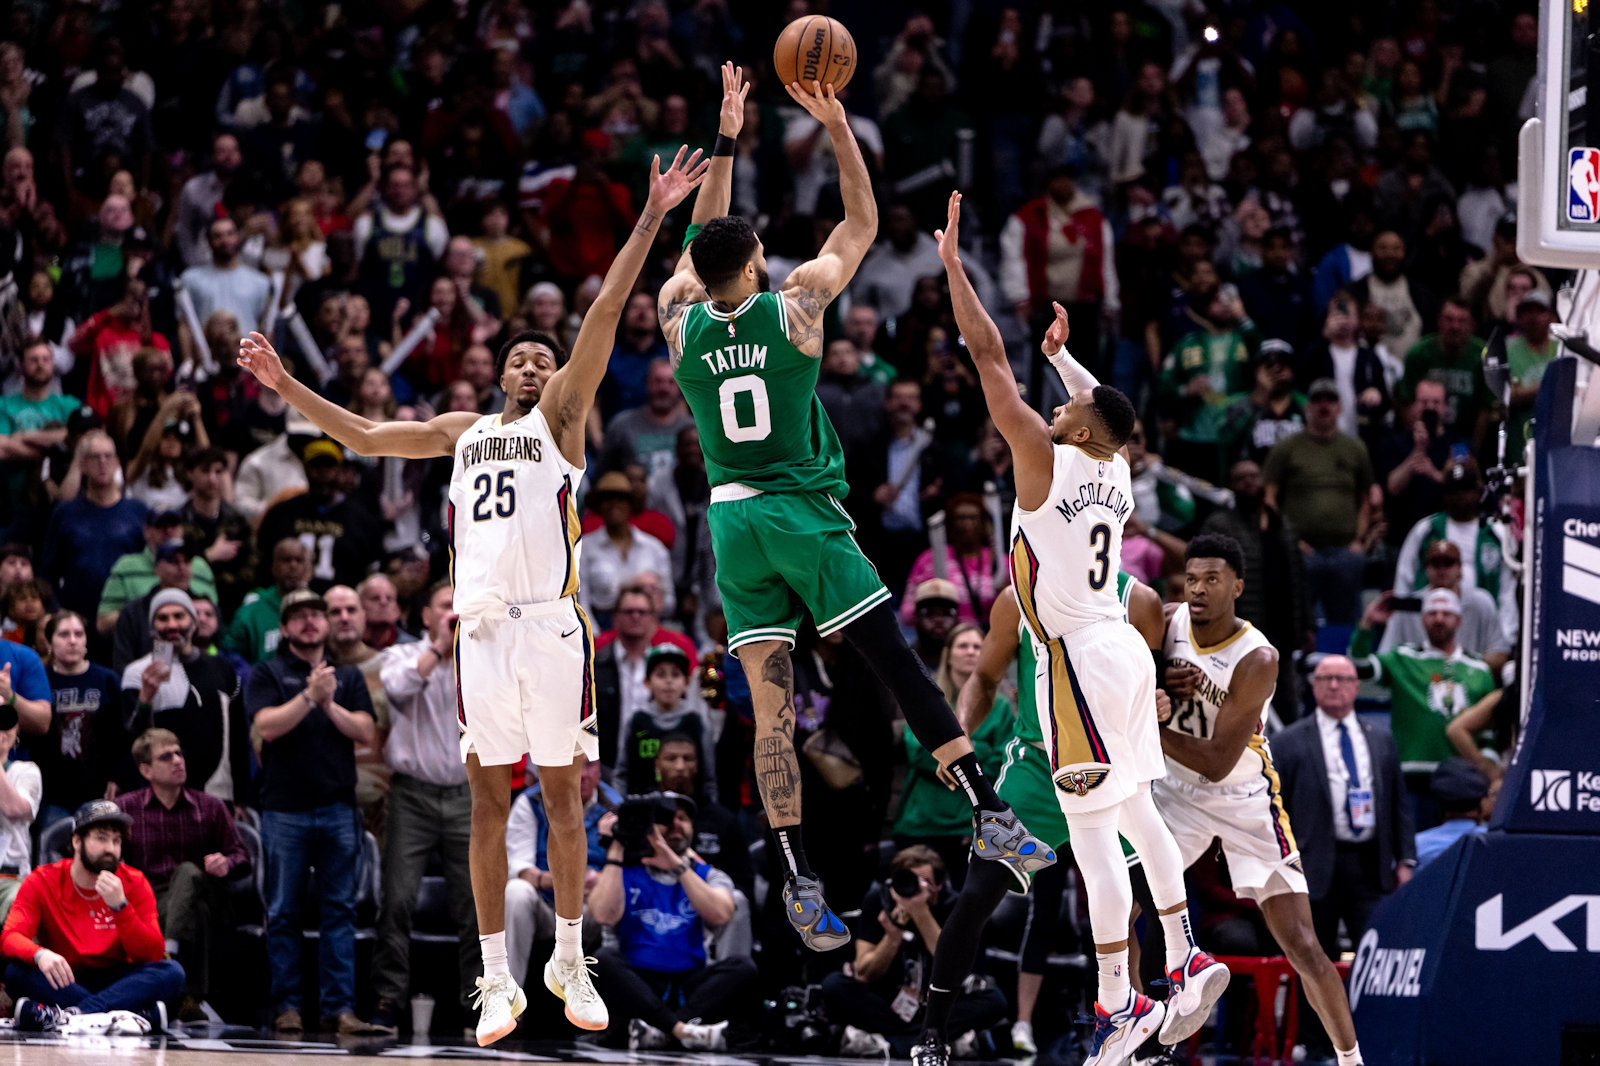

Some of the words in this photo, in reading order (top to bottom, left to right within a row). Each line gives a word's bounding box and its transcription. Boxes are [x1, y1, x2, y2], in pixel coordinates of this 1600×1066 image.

[803, 28, 826, 80] Wilson
[701, 343, 768, 375] TATUM
[718, 374, 772, 443] 0
[473, 469, 515, 522] 25
[1056, 482, 1130, 524] McCOLLUM
[1088, 522, 1111, 592] 3
[766, 771, 789, 789] QUIT
[629, 888, 641, 905] 7
[1364, 948, 1426, 997] FANDUEL
